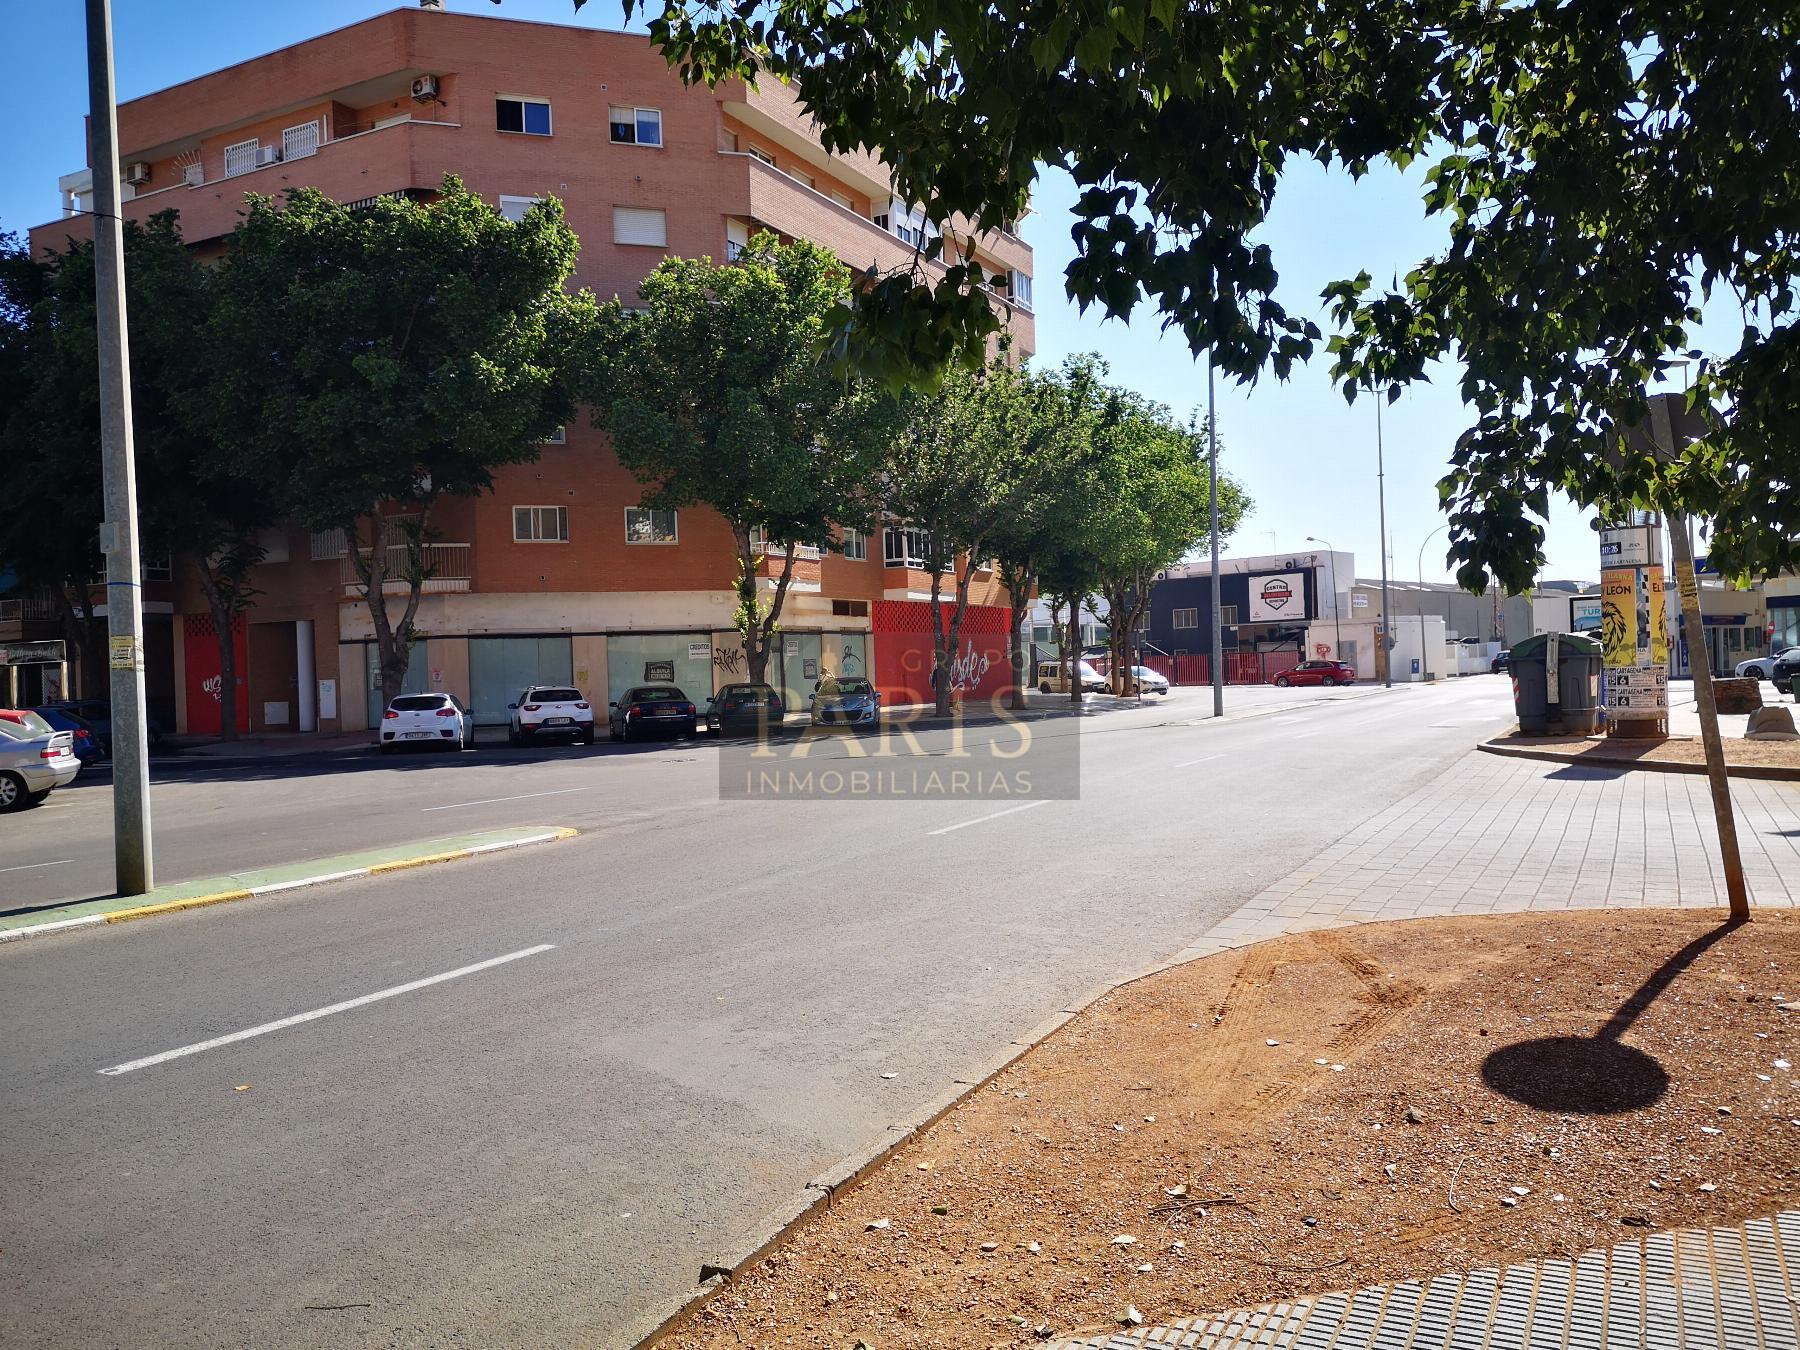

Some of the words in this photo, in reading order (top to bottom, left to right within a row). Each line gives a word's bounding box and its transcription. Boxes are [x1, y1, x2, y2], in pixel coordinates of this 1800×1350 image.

[1606, 583, 1632, 596] LEÓN
[1652, 582, 1662, 593] EL
[1617, 666, 1642, 674] CARTAGENA
[1618, 688, 1642, 696] CARTAGENA
